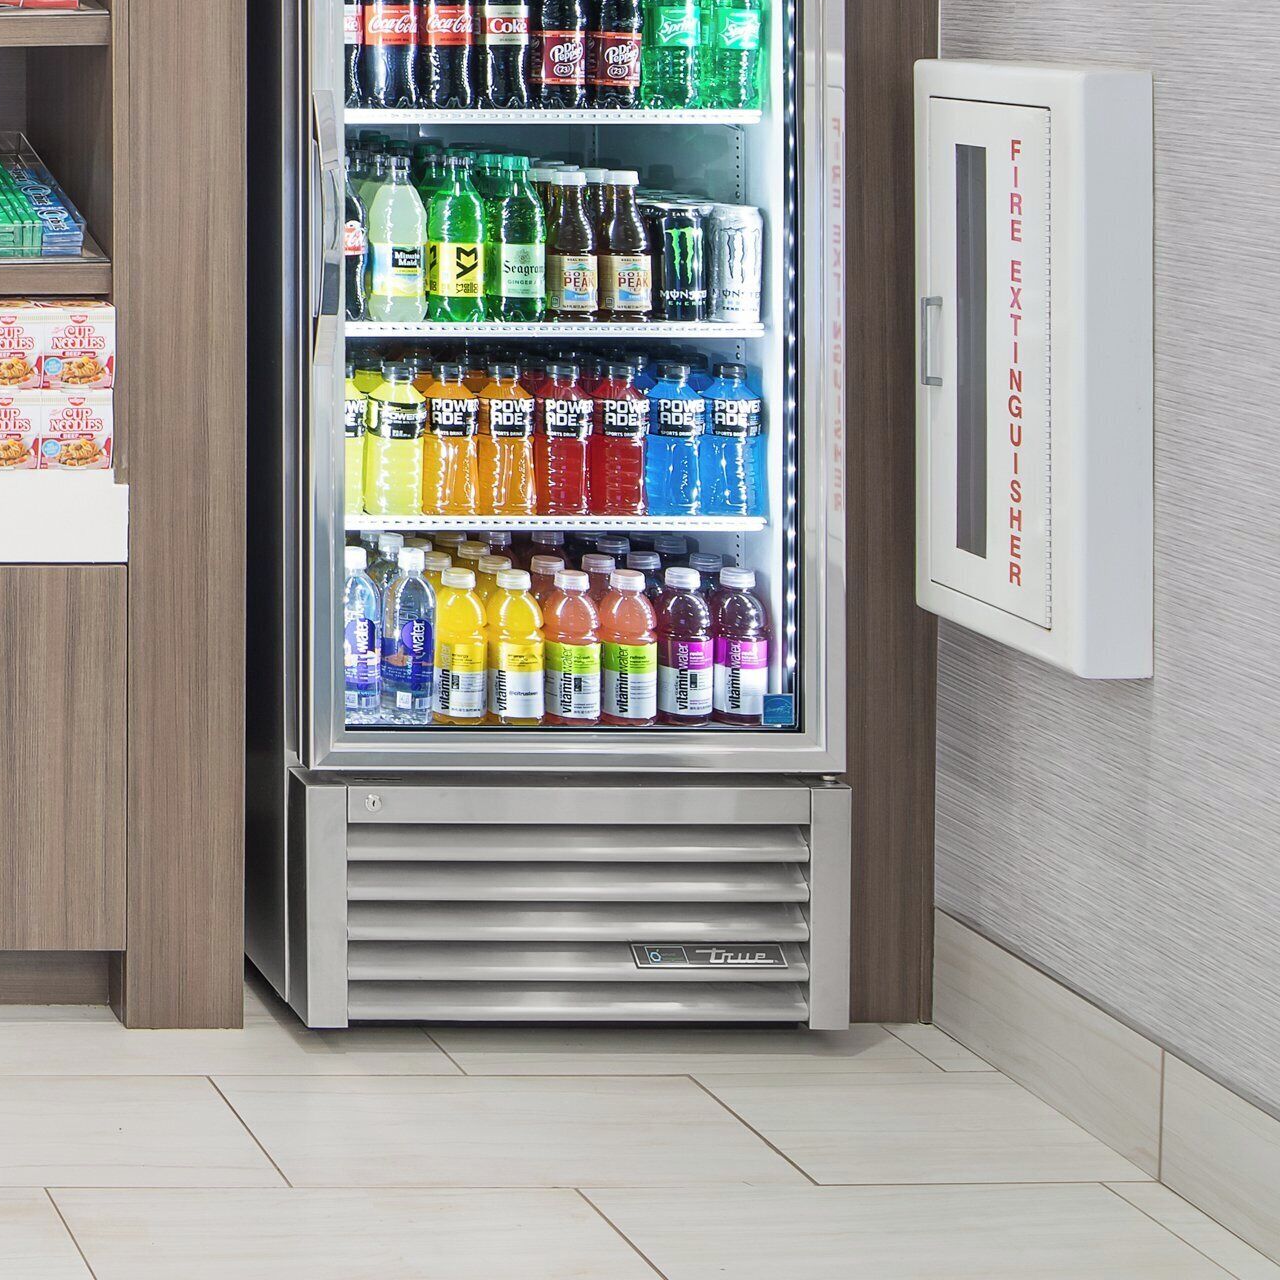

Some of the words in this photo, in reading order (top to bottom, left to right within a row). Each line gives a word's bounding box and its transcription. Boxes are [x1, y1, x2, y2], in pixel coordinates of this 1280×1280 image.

[490, 18, 528, 34] Coke
[564, 43, 577, 53] Dr
[1010, 139, 1023, 243] FIRE
[394, 251, 420, 260] Minute
[398, 258, 418, 266] Maid
[563, 277, 596, 288] PEAK
[618, 277, 649, 288] PEAK
[63, 325, 95, 338] CUP
[51, 335, 106, 350] NOODLES
[432, 398, 480, 412] POWER
[62, 407, 92, 420] CUP
[432, 412, 465, 426] ADE
[490, 412, 523, 426] ADE
[546, 413, 578, 426] ADE
[606, 413, 638, 426] ADE
[49, 417, 103, 433] NOODLES
[1007, 259, 1024, 587] EXTINGUISHER
[356, 620, 369, 654] water
[413, 619, 426, 653] water
[562, 648, 573, 713] vitaminwater
[618, 646, 629, 714] vitaminwater
[678, 642, 689, 711] vitaminwater
